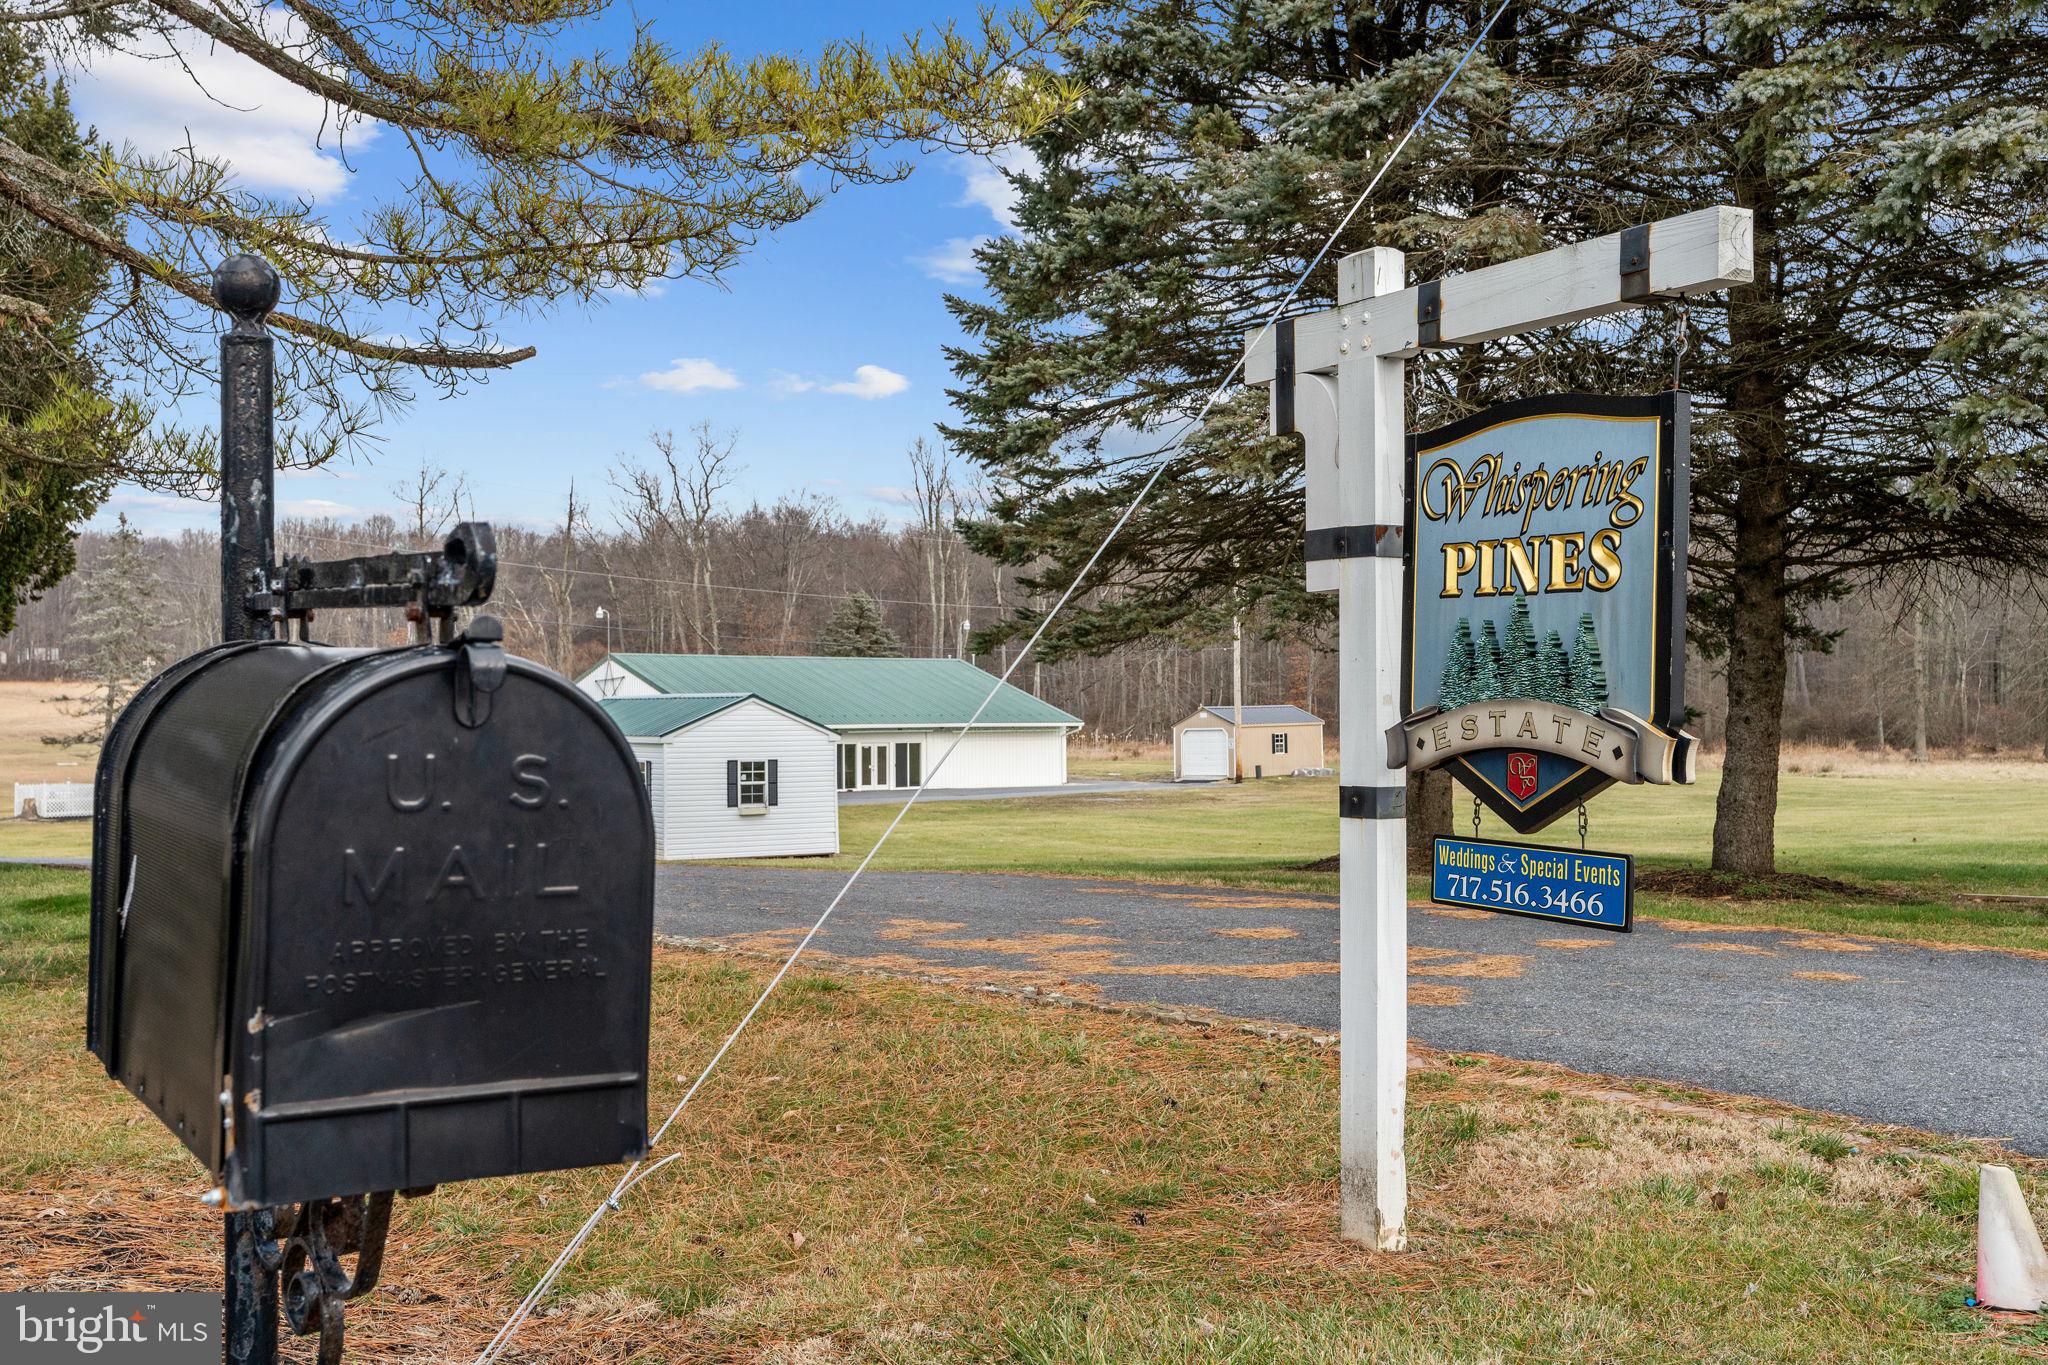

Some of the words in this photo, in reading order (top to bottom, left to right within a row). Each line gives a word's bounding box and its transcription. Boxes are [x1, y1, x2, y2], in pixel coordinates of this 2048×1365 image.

[1421, 451, 1650, 534] Whispering
[1440, 529, 1623, 598] PINES
[1431, 710, 1606, 758] ESTATE
[342, 843, 580, 906] MAIL
[1438, 845, 1495, 871] Weddings
[1498, 853, 1517, 873] &
[1521, 854, 1569, 881] Special
[1574, 860, 1620, 887] Events
[1447, 873, 1604, 917] 717.516.3466
[493, 932, 526, 953] BY
[540, 928, 590, 949] THE
